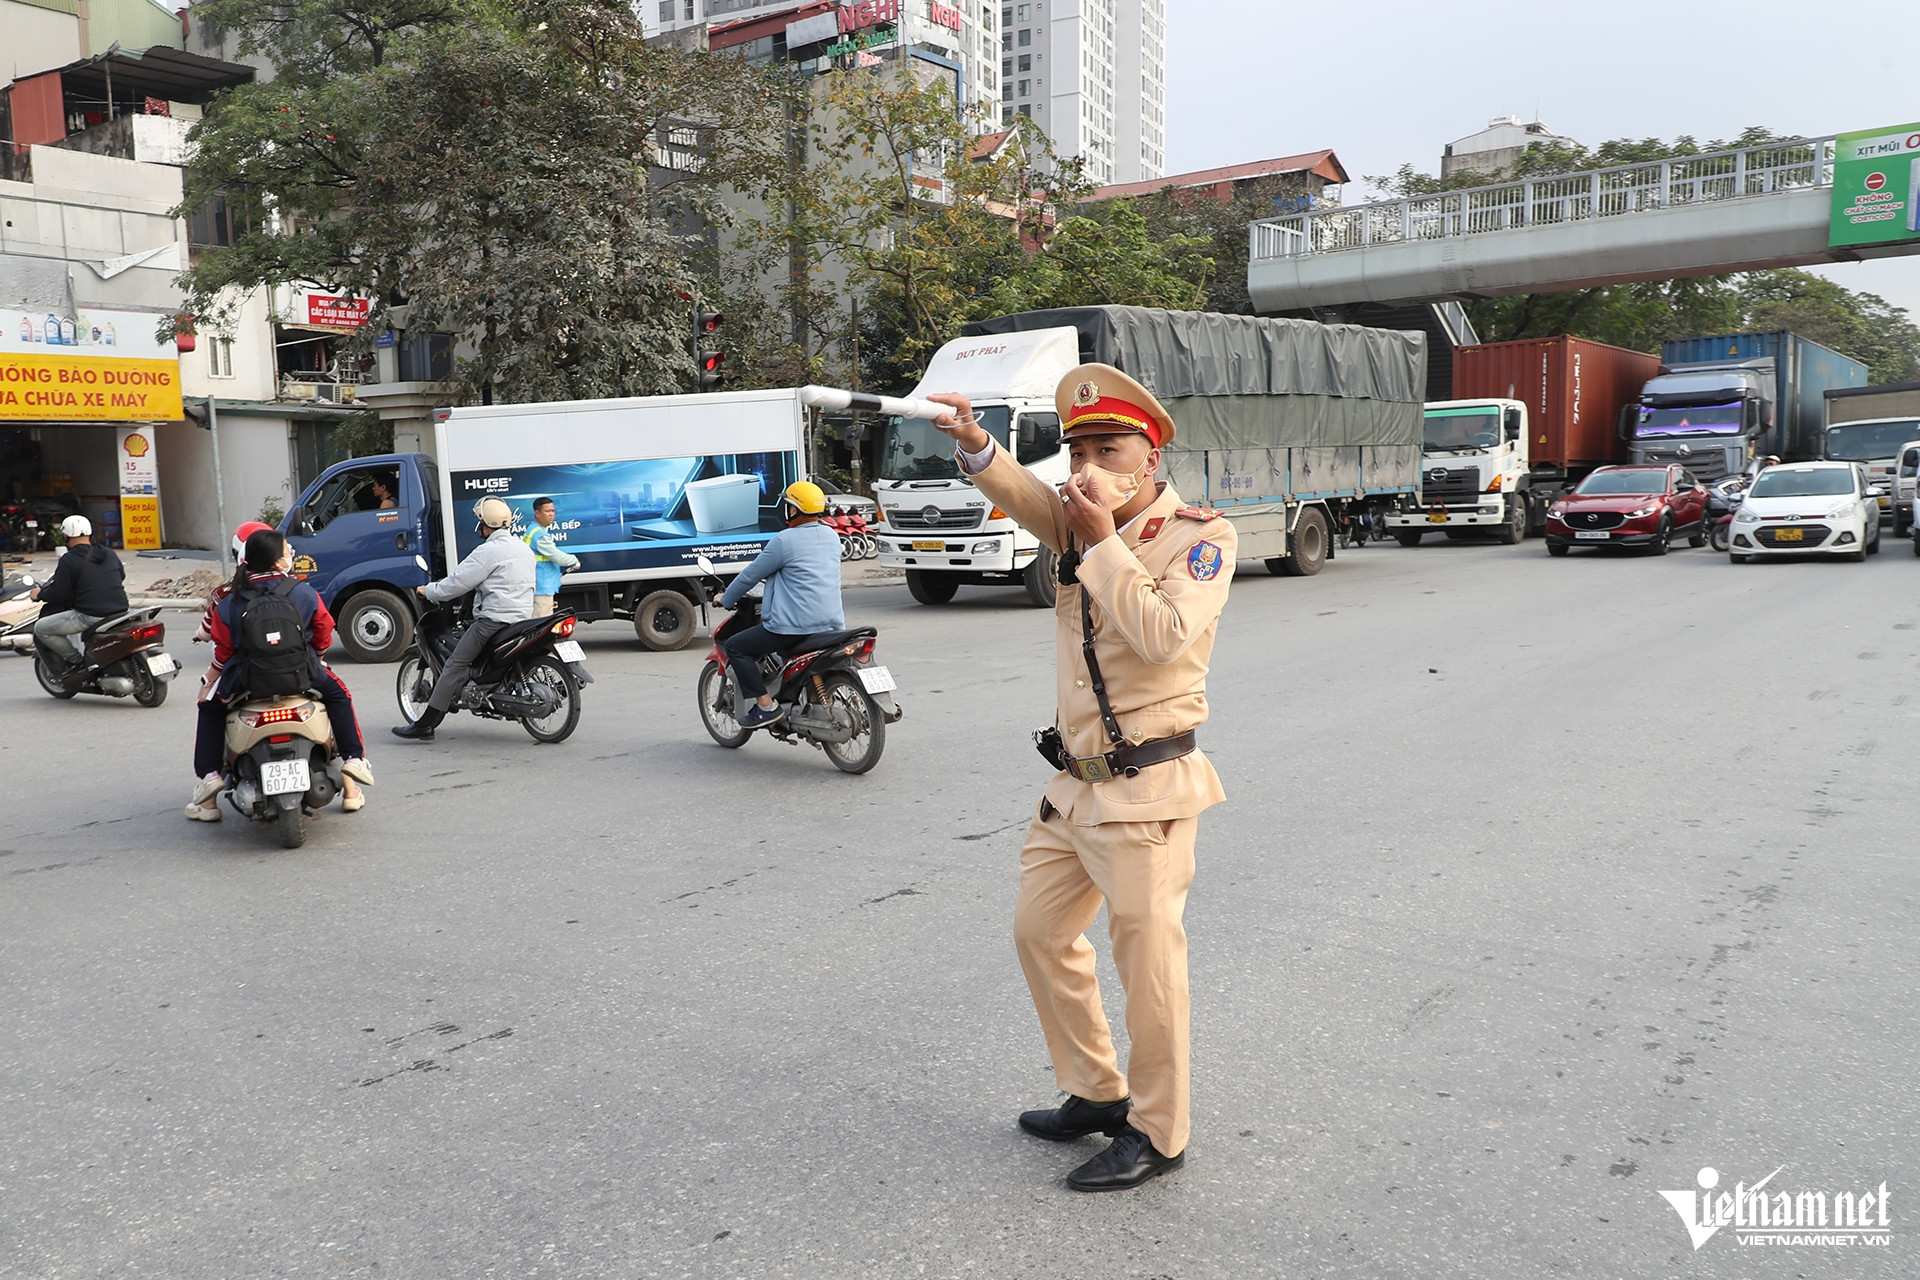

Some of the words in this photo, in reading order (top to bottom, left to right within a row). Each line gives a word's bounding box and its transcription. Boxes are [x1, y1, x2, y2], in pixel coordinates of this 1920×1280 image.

[1857, 145, 1876, 157] XỊT
[1878, 140, 1900, 153] MŨI
[1855, 192, 1893, 204] KHÔNG
[1844, 206, 1864, 215] CHẤT
[1880, 202, 1904, 212] MẠCH
[1851, 212, 1895, 223] CORTICOID
[311, 306, 323, 316] CÁC
[338, 310, 346, 319] XE
[955, 349, 978, 361] DUY
[58, 366, 97, 384] BẢO
[103, 368, 171, 386] DƯỠNG
[24, 389, 78, 406] CHỮA
[83, 392, 105, 407] XE
[111, 391, 148, 407] MÁY
[561, 519, 581, 530] BẾP
[269, 762, 301, 778] 29-AC
[266, 776, 306, 792] 607.24
